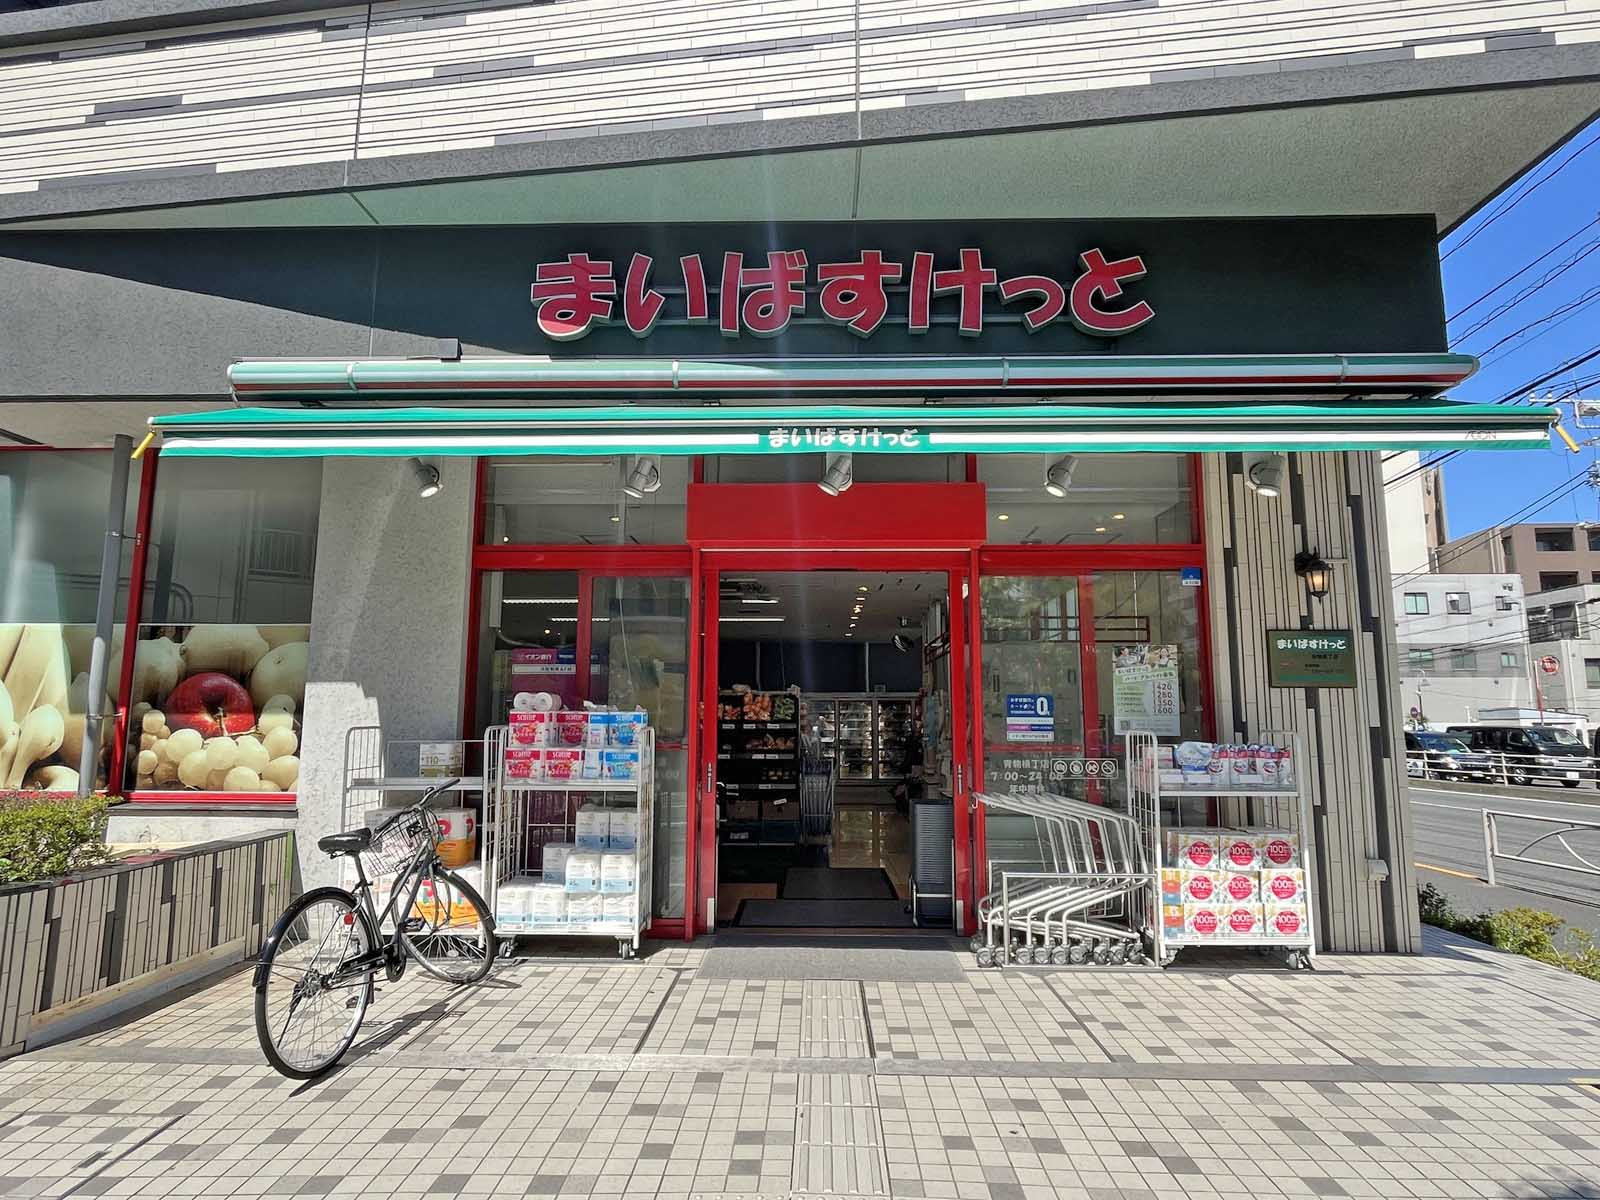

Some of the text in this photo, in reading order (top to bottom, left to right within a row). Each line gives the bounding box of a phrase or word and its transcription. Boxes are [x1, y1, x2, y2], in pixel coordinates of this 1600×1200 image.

[530, 247, 1156, 341] まいばすけっと
[768, 427, 921, 448] まいばすけっと
[1276, 638, 1347, 650] まいばすけっと
